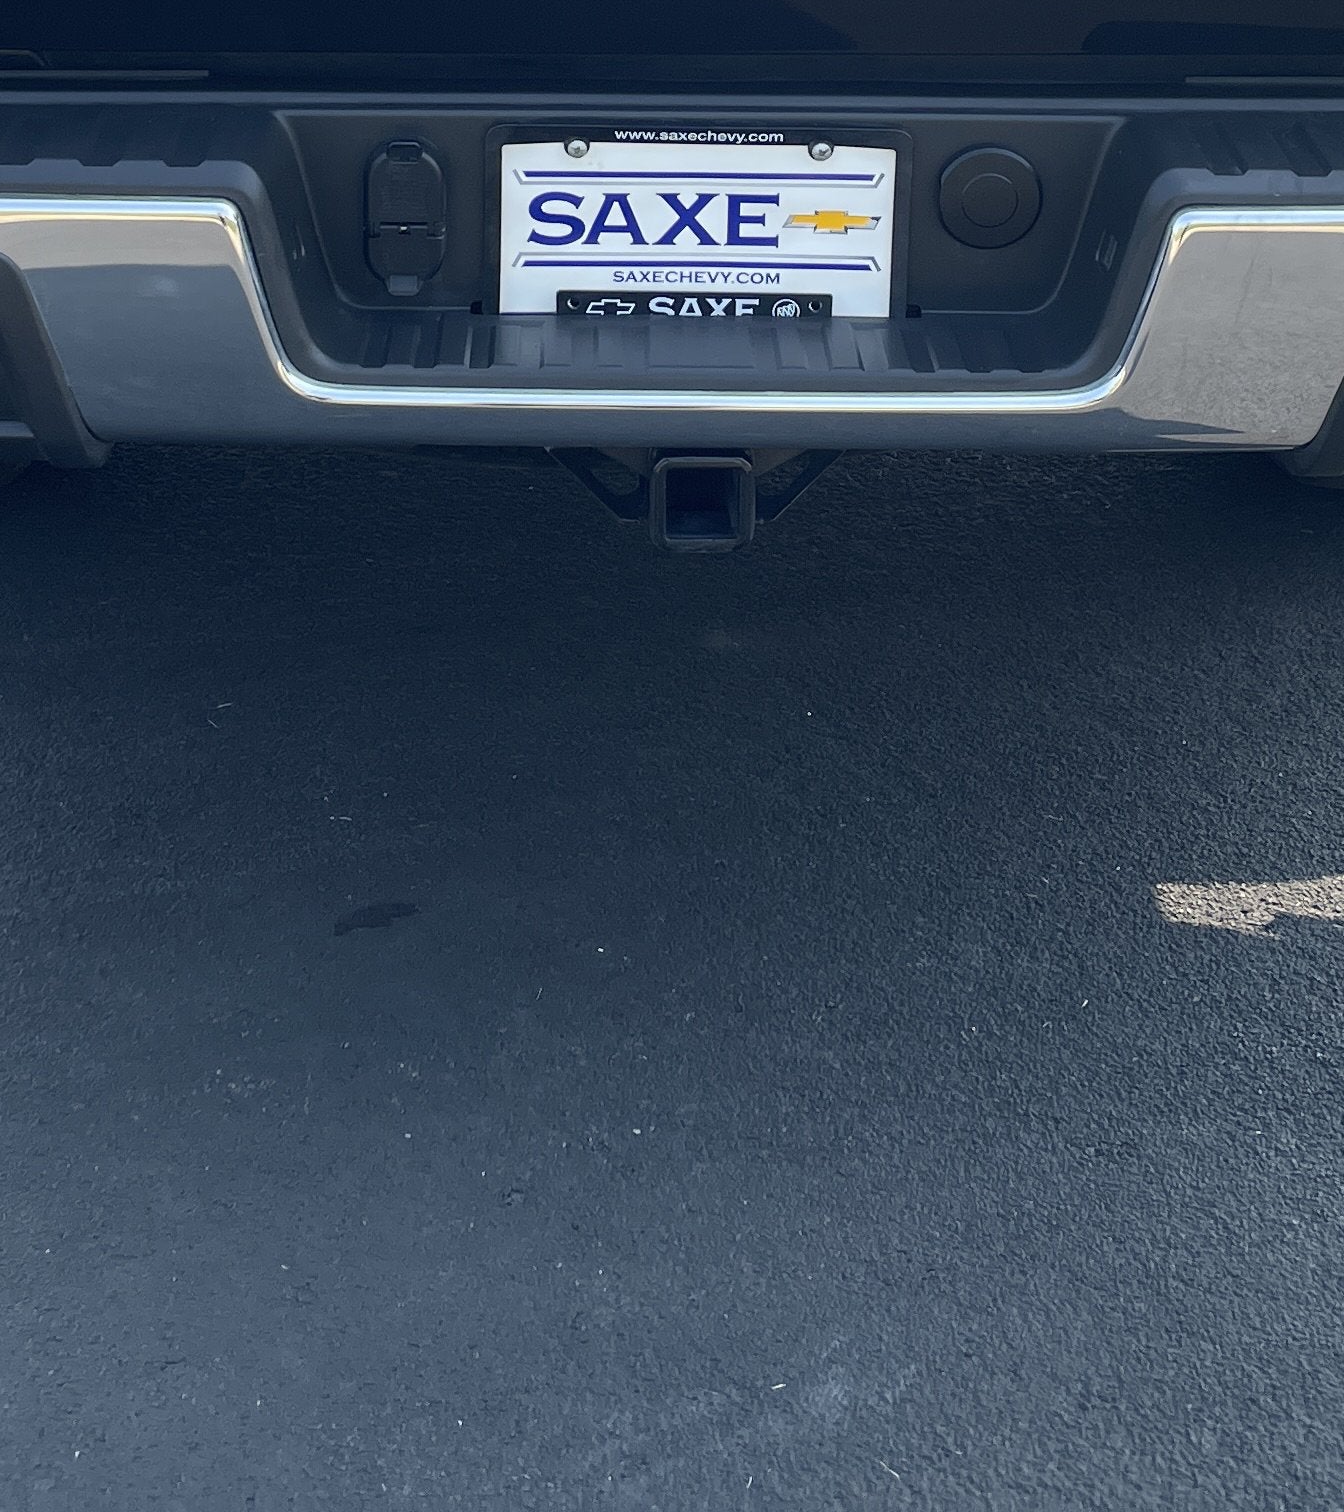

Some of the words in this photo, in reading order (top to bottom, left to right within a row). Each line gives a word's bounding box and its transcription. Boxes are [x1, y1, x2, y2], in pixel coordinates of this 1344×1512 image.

[614, 130, 784, 145] www.saxechevy.com
[527, 191, 781, 248] SAXE
[612, 270, 781, 285] SAXECHEVY.COM
